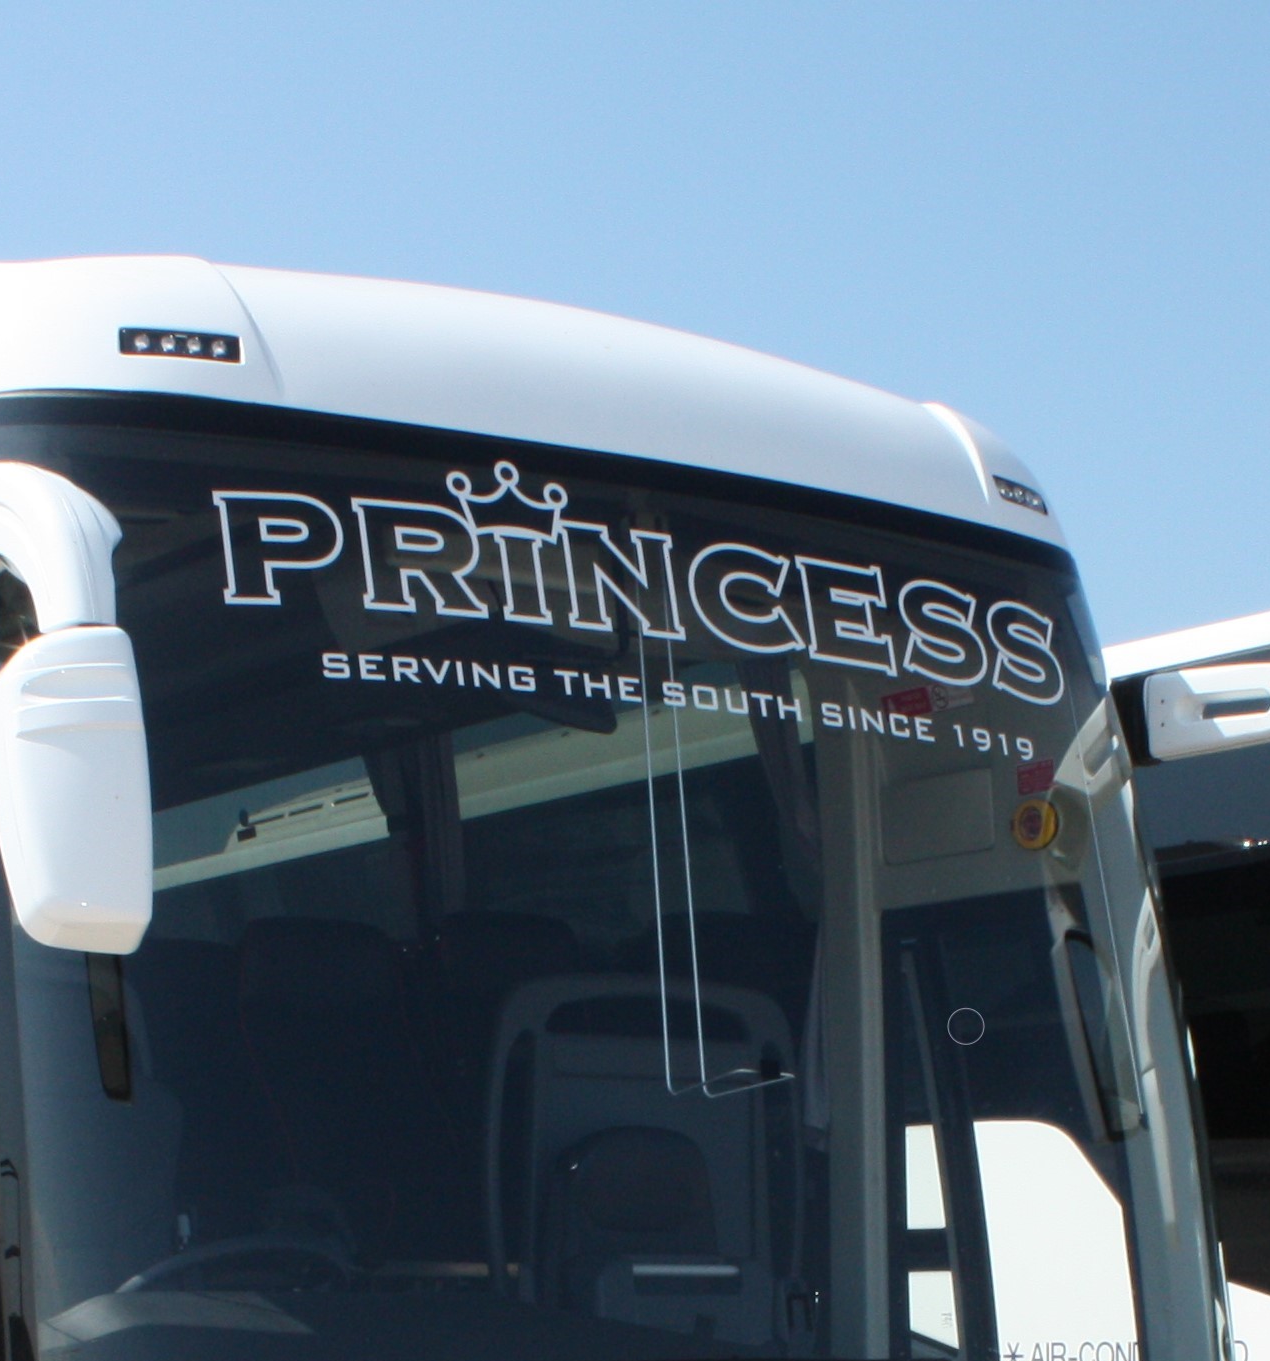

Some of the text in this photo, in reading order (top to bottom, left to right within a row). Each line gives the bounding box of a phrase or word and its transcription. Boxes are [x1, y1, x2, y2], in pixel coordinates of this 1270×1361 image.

[212, 489, 1065, 706] PRINCESS
[321, 652, 1034, 762] SERVING THE SOUTH SINCE 1919
